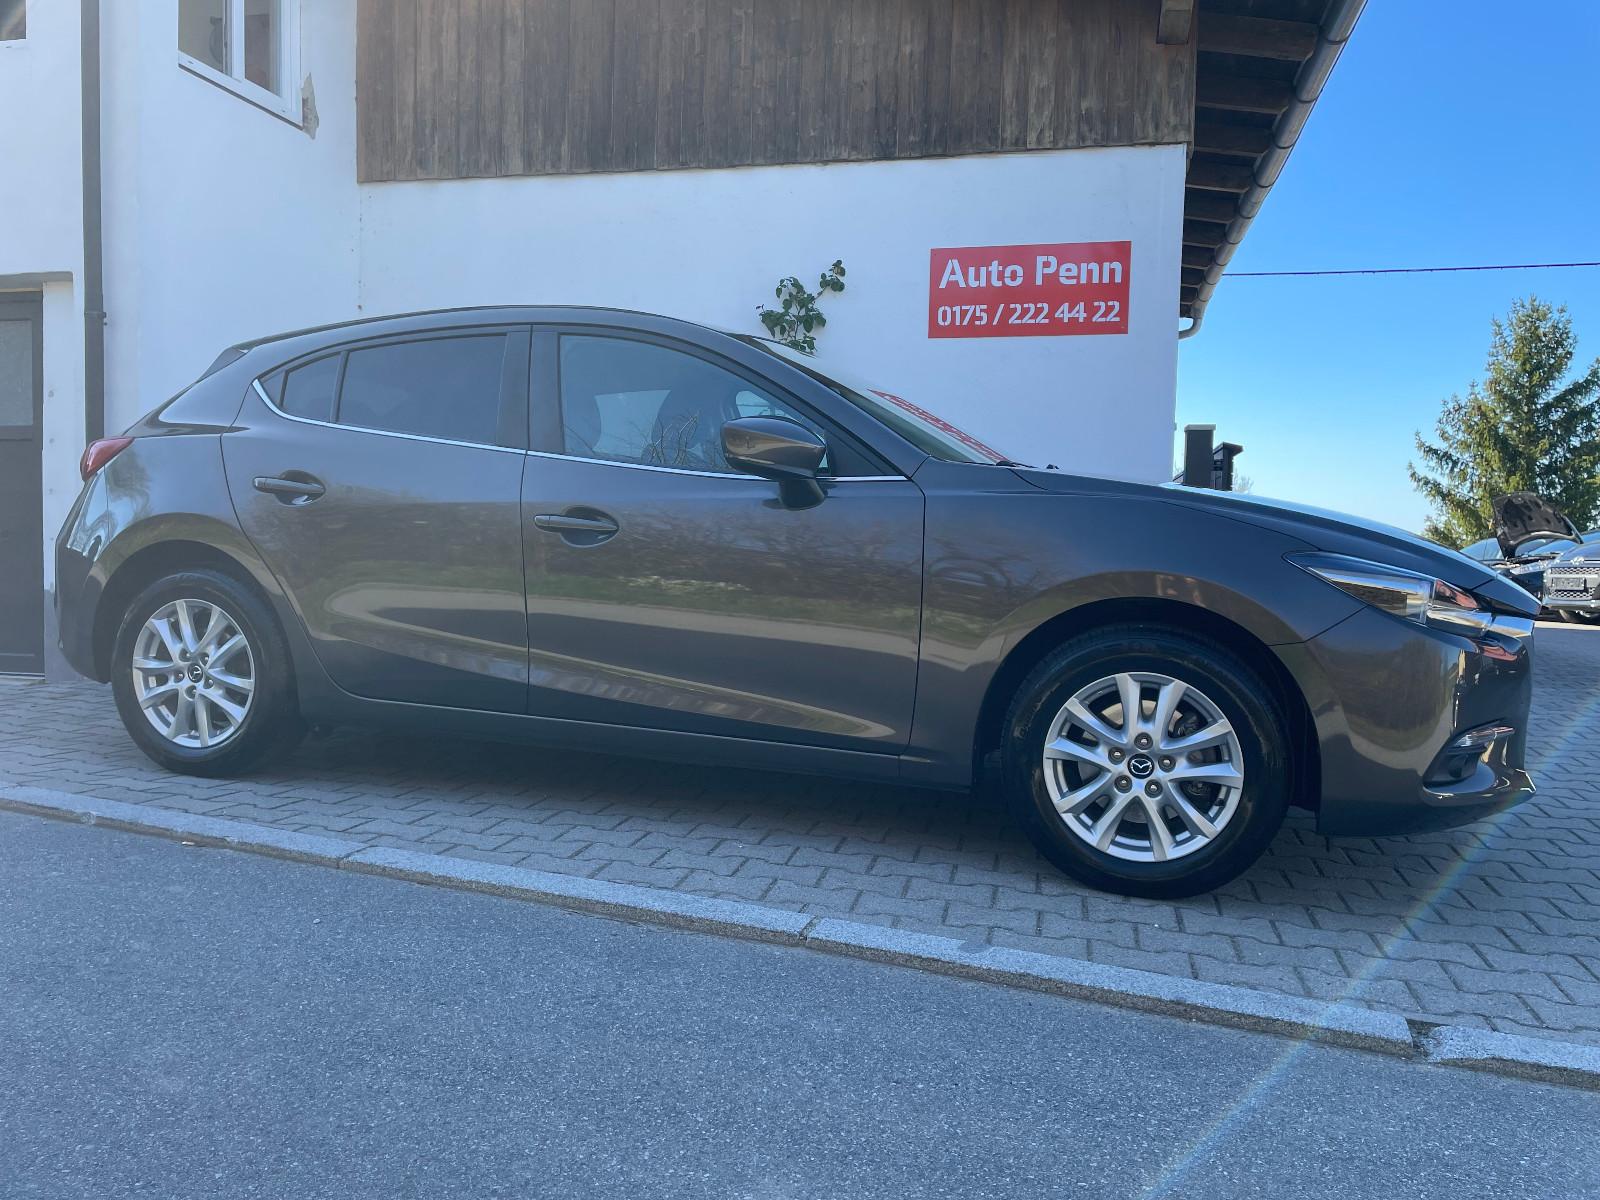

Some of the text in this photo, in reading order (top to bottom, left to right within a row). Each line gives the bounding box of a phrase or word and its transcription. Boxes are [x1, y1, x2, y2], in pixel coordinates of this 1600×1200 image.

[939, 255, 1123, 289] Auto Penn
[937, 304, 988, 326] 0175
[1008, 302, 1049, 324] 222
[1054, 301, 1087, 323] 44
[1092, 300, 1121, 322] 22
